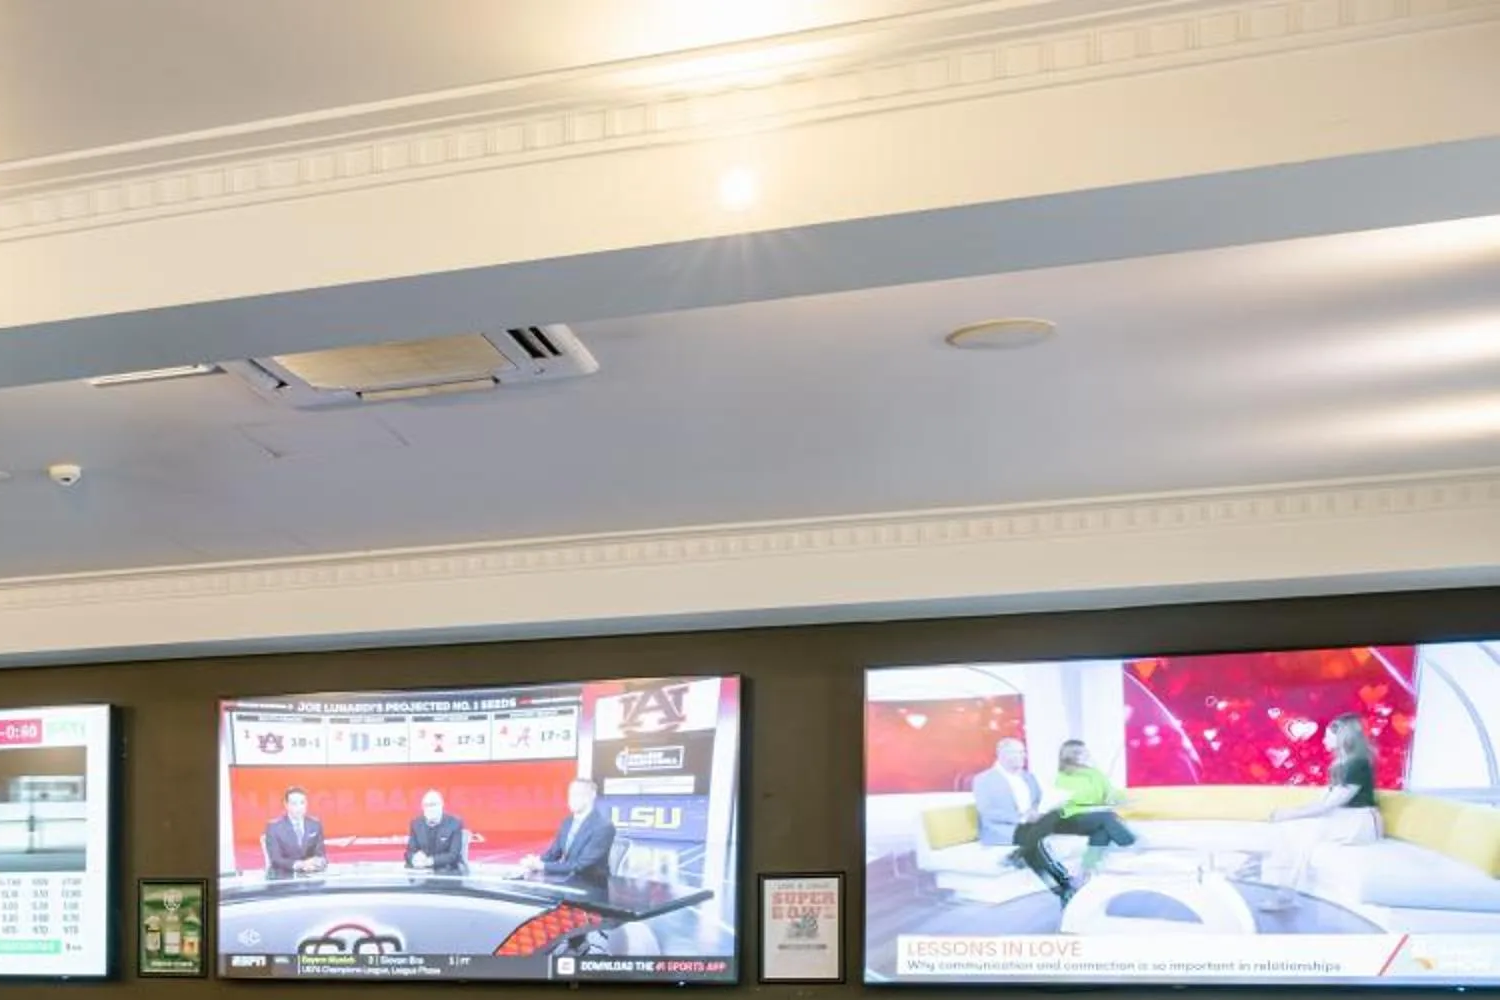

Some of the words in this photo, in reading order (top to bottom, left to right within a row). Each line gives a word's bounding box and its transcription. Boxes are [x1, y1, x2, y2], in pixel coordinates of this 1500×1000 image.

[298, 702, 322, 713] JOE
[385, 701, 450, 713] PROJECTED
[481, 698, 517, 710] SEEDS
[457, 734, 485, 745] 17-3
[541, 730, 571, 742] 17-3
[611, 805, 682, 830] LSU
[772, 891, 835, 905] SUPER
[907, 940, 997, 957] LESSONS
[1003, 940, 1023, 957] IN
[1029, 940, 1082, 957] LOVE
[232, 955, 266, 967] ESPN
[580, 960, 633, 971] DOWNLOAD
[635, 961, 654, 971] THE
[667, 961, 704, 972] SPORTS
[706, 962, 727, 972] APP
[908, 960, 934, 971] Why
[939, 960, 1032, 970] communication
[1037, 960, 1060, 970] and
[1064, 960, 1135, 970] connection
[1138, 960, 1148, 971] is
[1153, 962, 1166, 971] so
[1169, 960, 1234, 972] important
[1239, 960, 1251, 971] in
[1253, 959, 1341, 972] relationships
